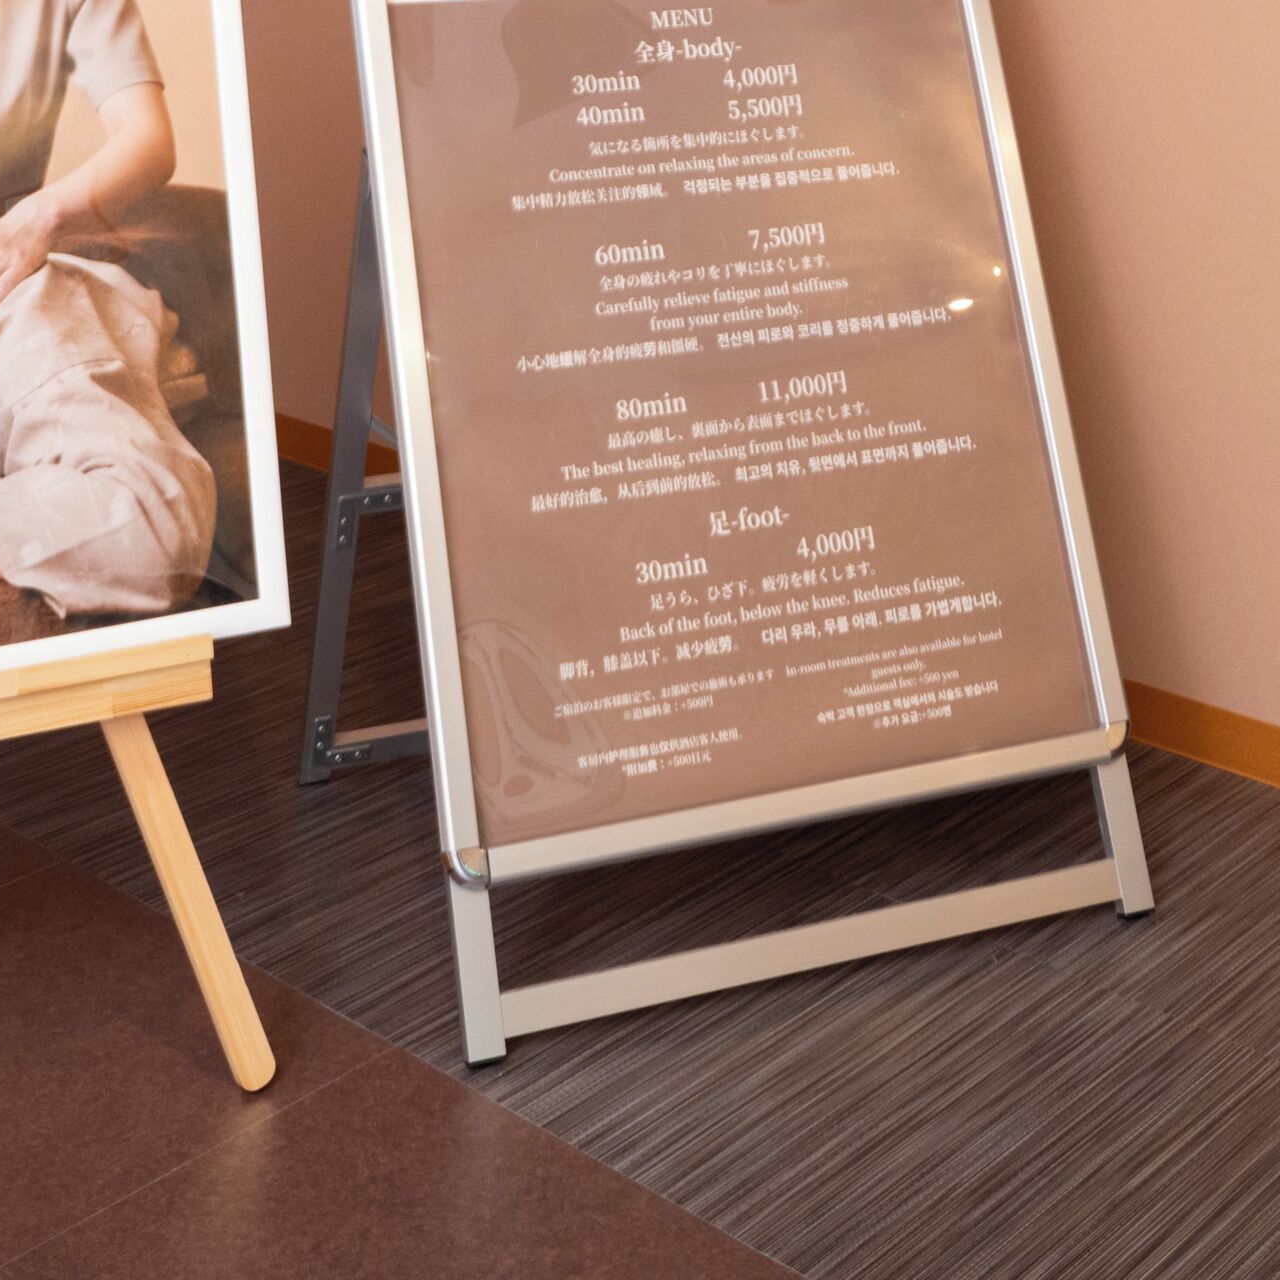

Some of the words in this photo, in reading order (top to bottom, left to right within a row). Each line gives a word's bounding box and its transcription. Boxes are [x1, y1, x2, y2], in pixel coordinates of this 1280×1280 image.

[649, 7, 714, 29] MENU
[634, 35, 743, 63] 全身-body-
[571, 69, 642, 95] 30min
[722, 63, 798, 92] 4,000円
[576, 101, 646, 127] 40min
[727, 93, 803, 123] 5,500円
[548, 164, 635, 183] Concentrate
[637, 163, 656, 175] on
[658, 156, 716, 174] relaxing
[717, 153, 739, 168] the
[742, 153, 778, 166] areas
[780, 146, 795, 162] of
[796, 146, 855, 160] concern.
[735, 172, 772, 191] 부분을
[774, 167, 835, 187] 집중적으로
[594, 239, 666, 266] 60min
[747, 221, 825, 253] 7,500円
[594, 295, 659, 316] Carefully
[663, 291, 710, 309] relieve
[713, 286, 761, 304] fatigue
[764, 280, 790, 297] and
[792, 276, 849, 294] stiffness
[649, 315, 685, 331] from
[687, 313, 720, 331] your
[722, 305, 764, 322] entire
[766, 300, 803, 318] body.
[716, 329, 755, 350] 전신의
[757, 324, 795, 344] 피로와
[797, 319, 834, 339] 코리를
[836, 313, 885, 336] 정중하게
[615, 391, 688, 422] 80min
[758, 369, 848, 404] 11,000円
[560, 463, 591, 481] The
[592, 459, 624, 477] best
[626, 452, 686, 472] healing,
[688, 443, 747, 463] relaxing
[749, 439, 784, 455] from
[786, 434, 809, 450] the
[811, 428, 845, 447] back
[847, 428, 862, 441] to
[863, 423, 886, 439] the
[887, 419, 927, 436] front.
[735, 462, 774, 483] 최고의
[775, 459, 807, 477] 치유,
[808, 450, 859, 473] 뒷면에서
[860, 443, 910, 465] 표면까지
[709, 505, 790, 537] 足-foot-
[635, 552, 709, 585] 30min
[796, 524, 876, 562] 4,000円
[619, 621, 657, 643] Back
[658, 617, 676, 636] of
[676, 615, 701, 633] the
[703, 610, 738, 628] foot,
[739, 603, 783, 623] below
[786, 598, 809, 615] the
[811, 594, 850, 610] knee.
[853, 583, 911, 604] Reduces
[912, 575, 965, 594] fatigue.
[761, 625, 788, 646] 다리
[790, 620, 822, 641] 우라,
[823, 615, 850, 636] 무릎
[884, 603, 922, 624] 피로를
[785, 661, 827, 677] In-room
[827, 651, 881, 670] treatments
[881, 649, 898, 660] are
[898, 644, 919, 657] also
[919, 636, 962, 654] available
[962, 633, 978, 646] for
[978, 627, 1003, 643] hotel
[871, 664, 902, 680] guests
[903, 658, 927, 671] only.
[898, 677, 917, 688] fee:
[941, 669, 960, 684] yen
